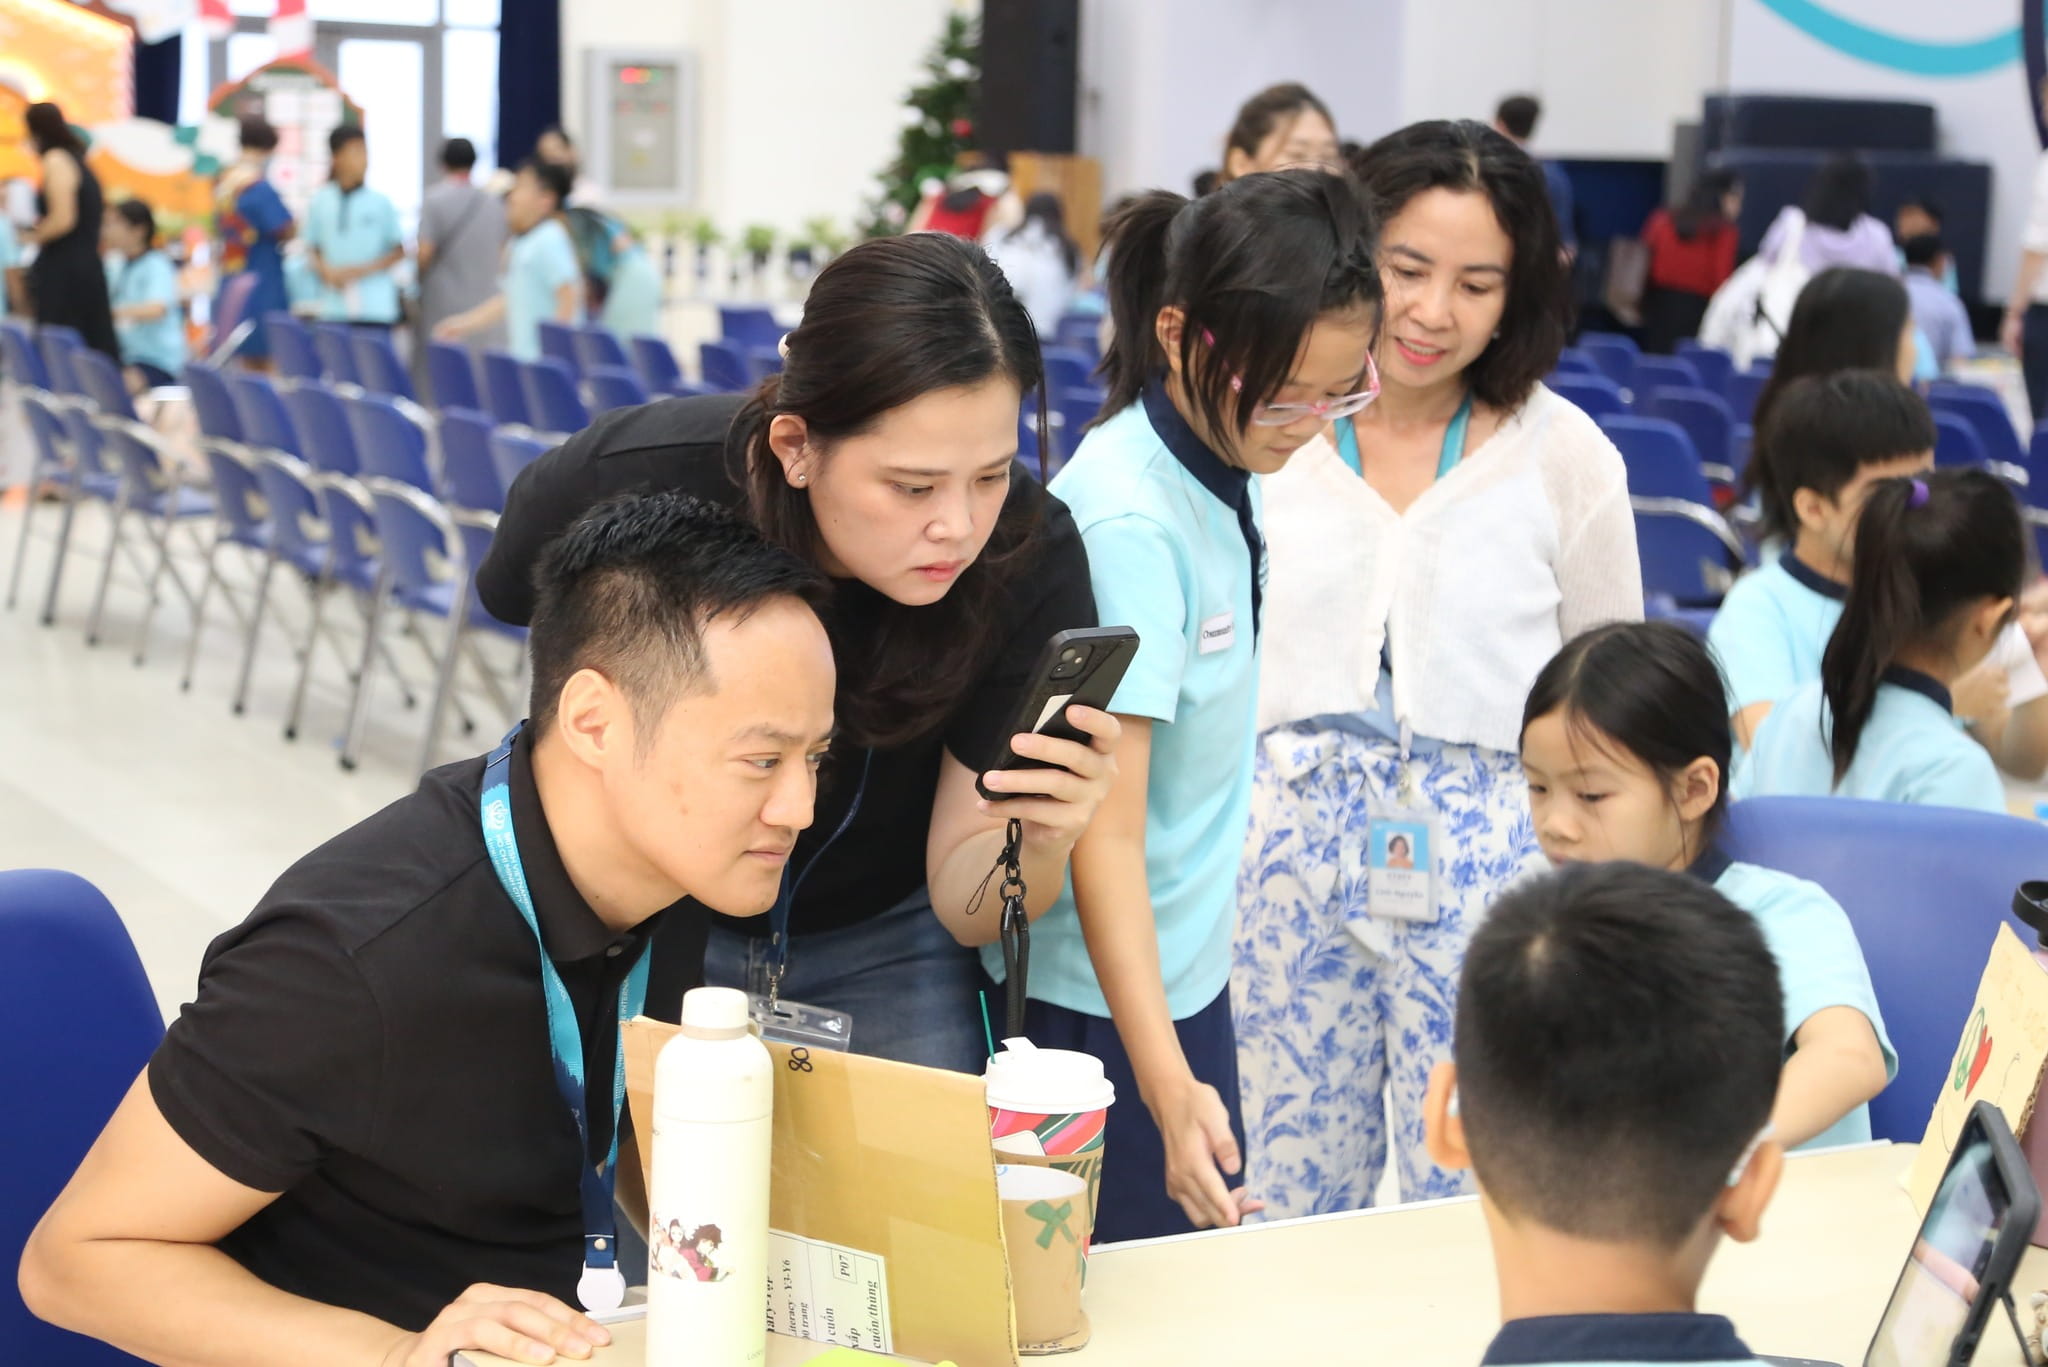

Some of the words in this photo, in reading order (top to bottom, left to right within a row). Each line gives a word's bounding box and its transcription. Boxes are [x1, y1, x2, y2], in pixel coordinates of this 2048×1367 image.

[782, 1259, 792, 1290] Y3-Y6
[839, 1254, 850, 1277] P07
[801, 1302, 809, 1329] trang
